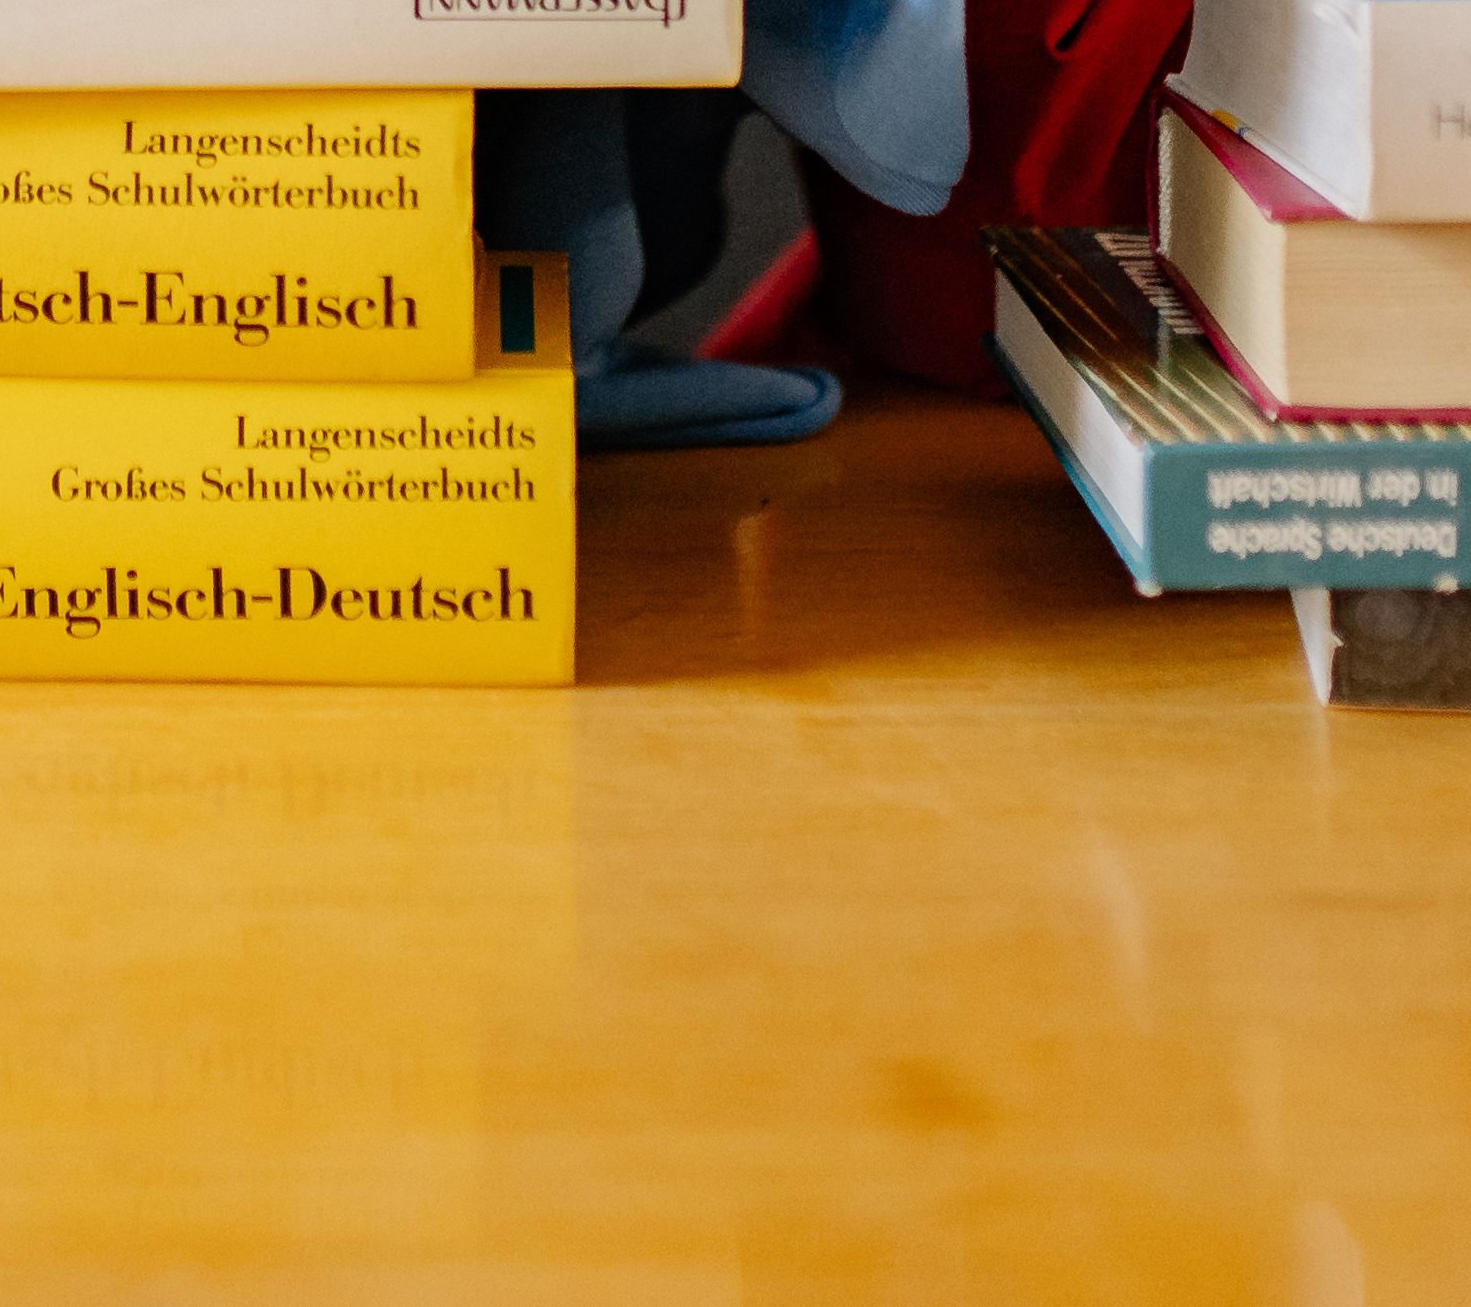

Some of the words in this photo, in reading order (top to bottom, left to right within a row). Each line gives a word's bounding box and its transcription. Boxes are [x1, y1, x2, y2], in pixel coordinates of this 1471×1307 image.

[123, 121, 421, 168] Langenscheidts
[87, 171, 420, 210] Schulwörterbuch
[235, 416, 536, 462] Langenscheidts
[51, 466, 186, 503] Großes
[200, 467, 536, 503] Schulwörterbuch
[1207, 467, 1363, 509] Wirtschaft
[1368, 467, 1422, 508] der
[1424, 467, 1459, 507] in
[1207, 515, 1323, 561] Sprache
[1326, 520, 1458, 560] Deutsche
